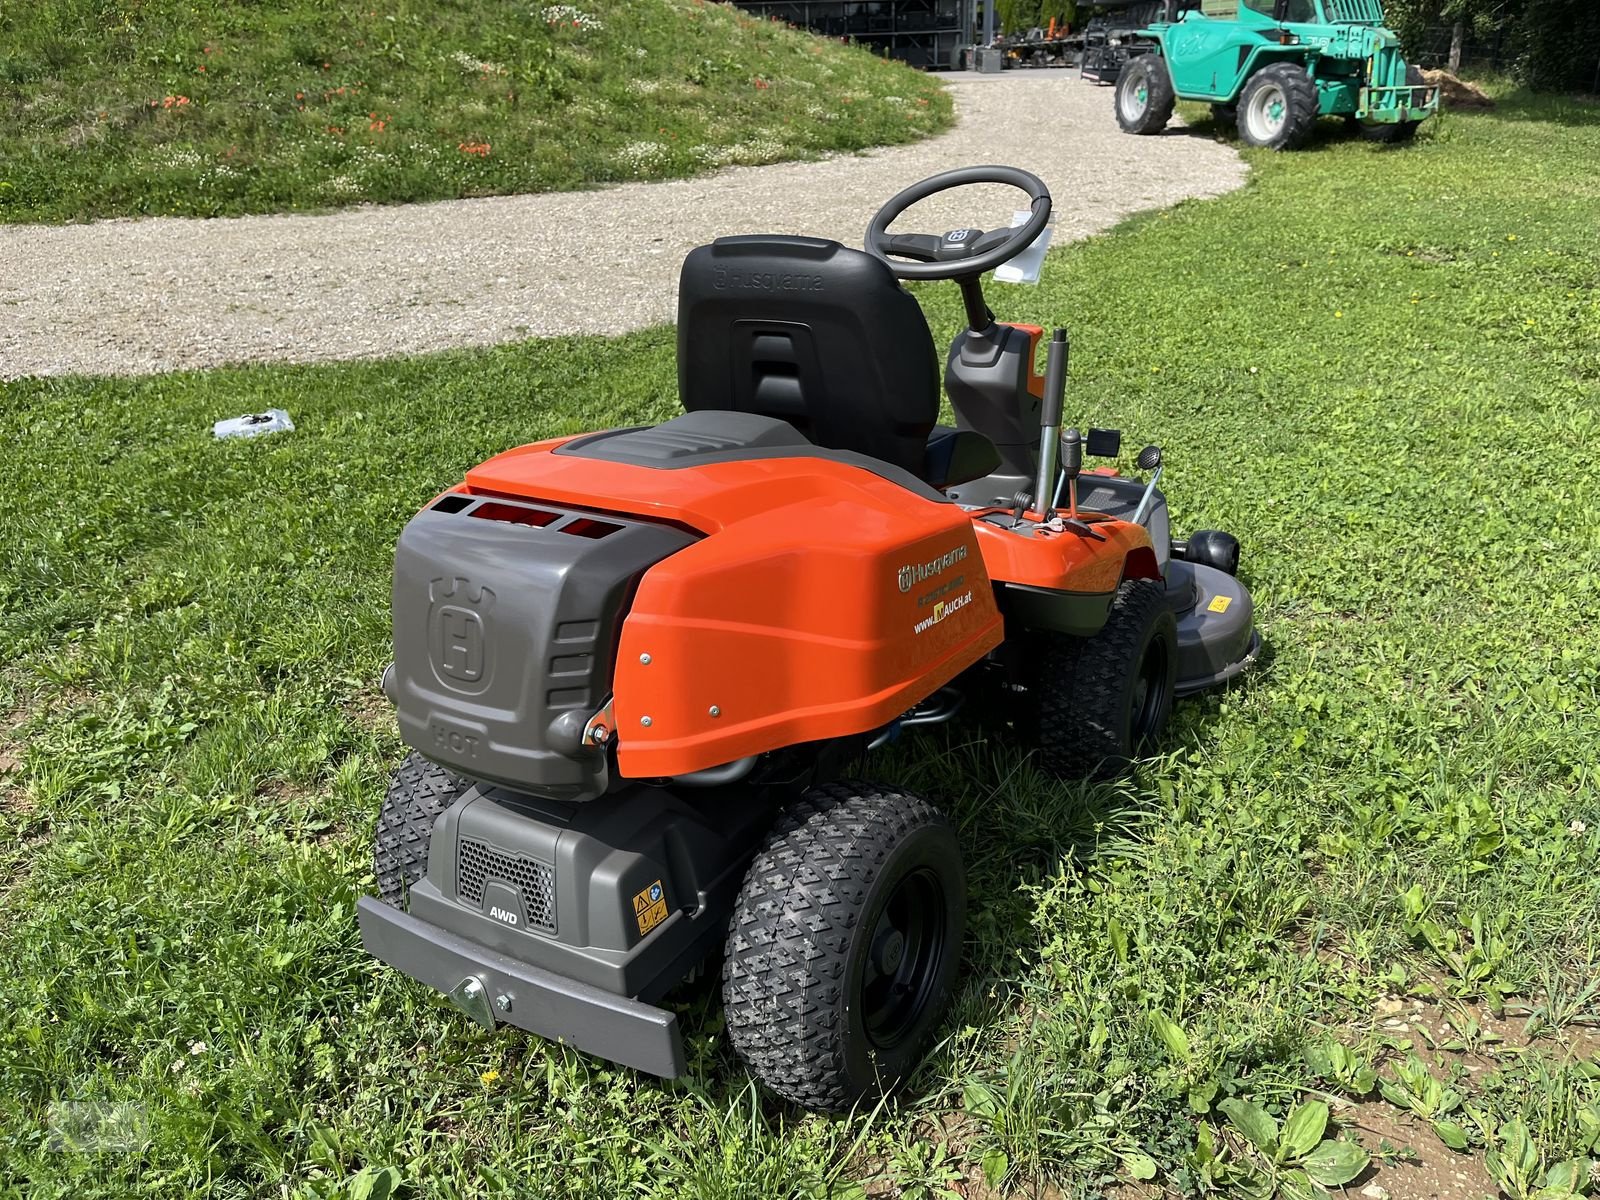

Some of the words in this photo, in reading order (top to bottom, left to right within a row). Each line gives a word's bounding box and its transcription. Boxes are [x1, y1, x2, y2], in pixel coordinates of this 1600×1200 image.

[730, 271, 824, 292] Husqvarna
[912, 544, 968, 584] Husqvarna
[913, 591, 972, 634] www.MAUCH.at
[432, 724, 480, 758] HOT
[490, 906, 518, 925] AWD
